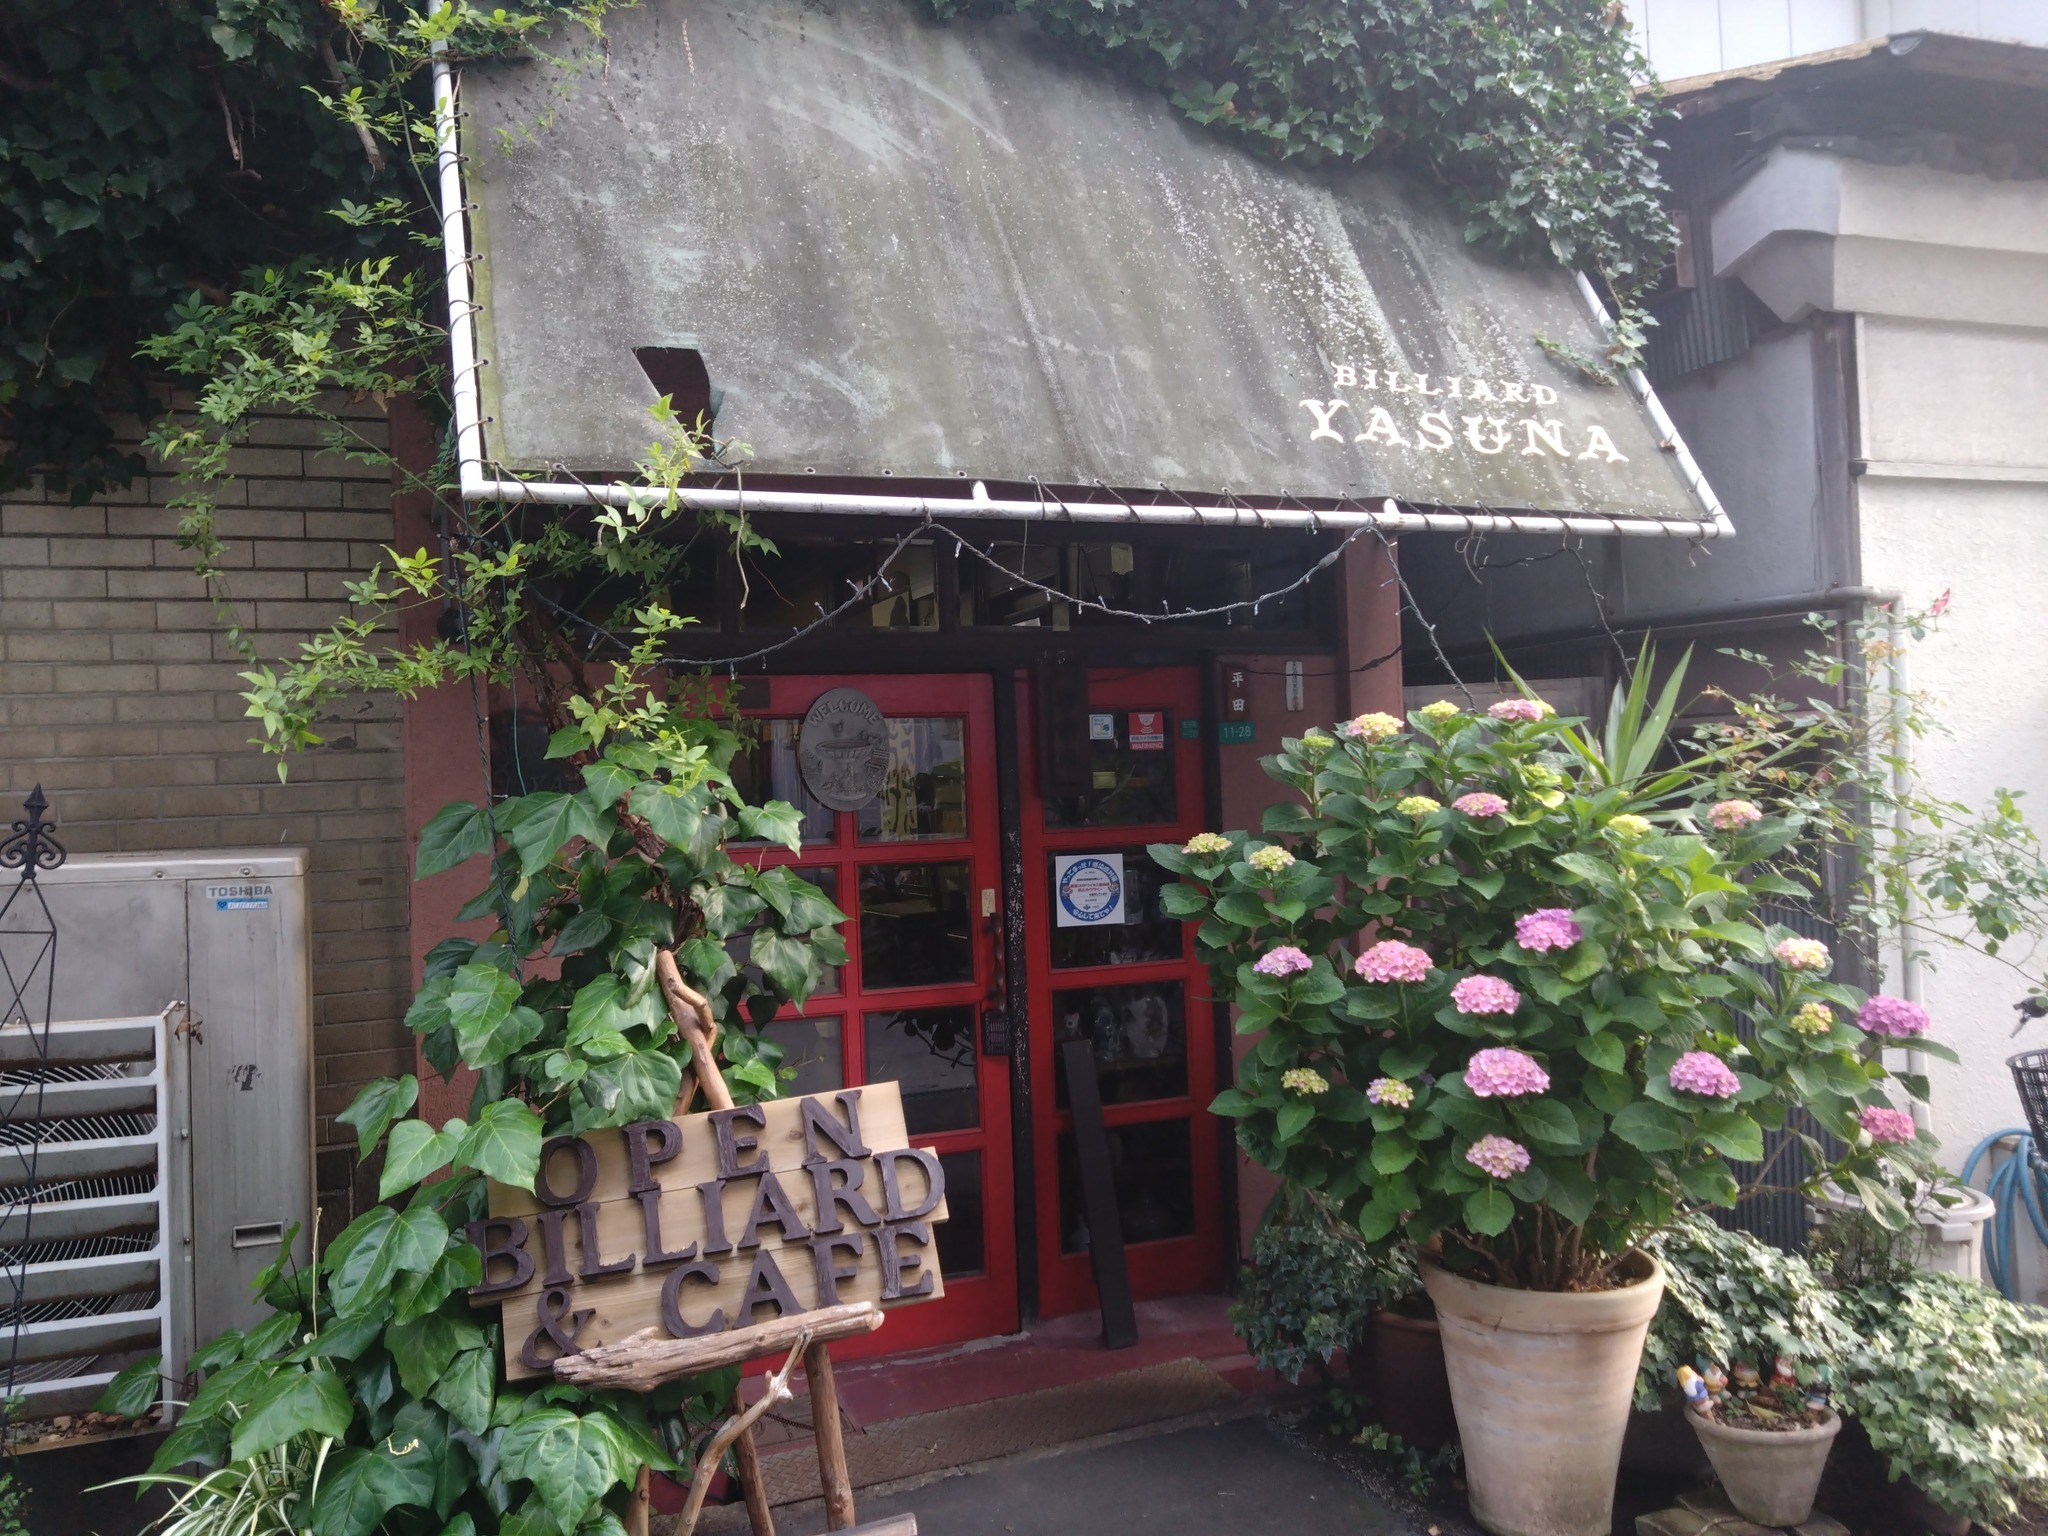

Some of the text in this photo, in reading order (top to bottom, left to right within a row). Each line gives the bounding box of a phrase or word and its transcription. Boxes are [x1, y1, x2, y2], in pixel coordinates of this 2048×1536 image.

[1330, 360, 1559, 405] BILLIARD
[1299, 398, 1630, 463] YASUNA
[806, 698, 885, 728] WELCOME
[1231, 671, 1245, 712] 平田
[1131, 742, 1164, 750] WARNING
[1223, 725, 1252, 738] 11-28
[208, 885, 273, 898] TOSHIBA
[534, 1088, 872, 1207] OPEN
[465, 1146, 946, 1295] BILLIARD
[518, 1221, 936, 1369] & CAFE
